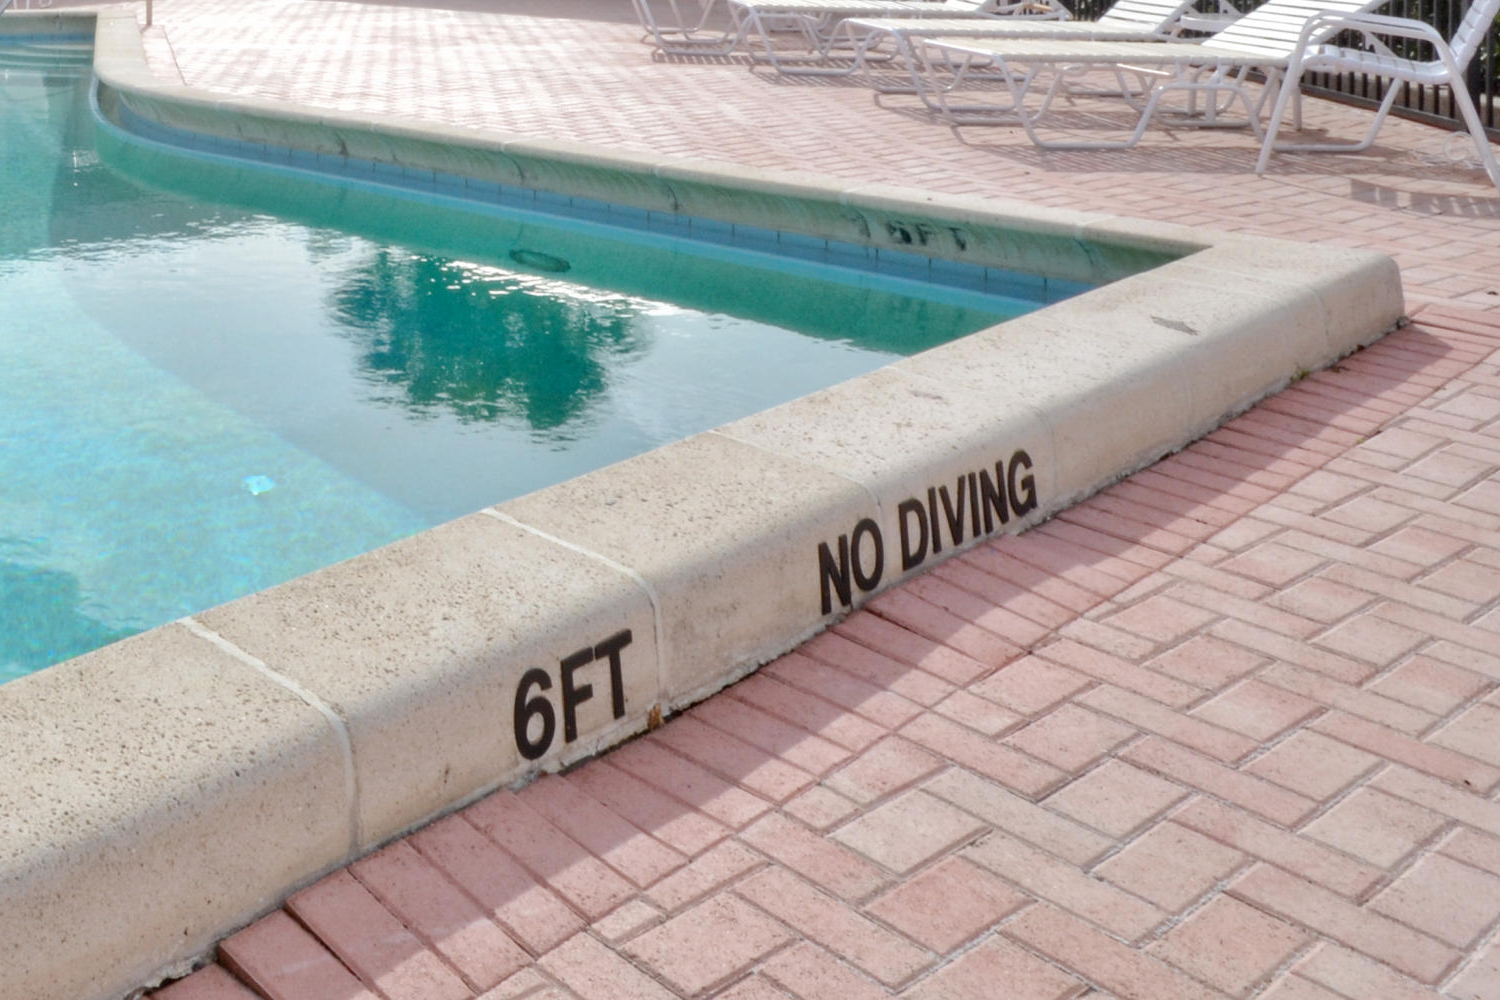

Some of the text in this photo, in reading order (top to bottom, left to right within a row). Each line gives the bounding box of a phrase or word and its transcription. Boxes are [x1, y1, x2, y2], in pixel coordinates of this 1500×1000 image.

[818, 448, 1038, 616] NO DIVING
[514, 628, 633, 761] 6FT
